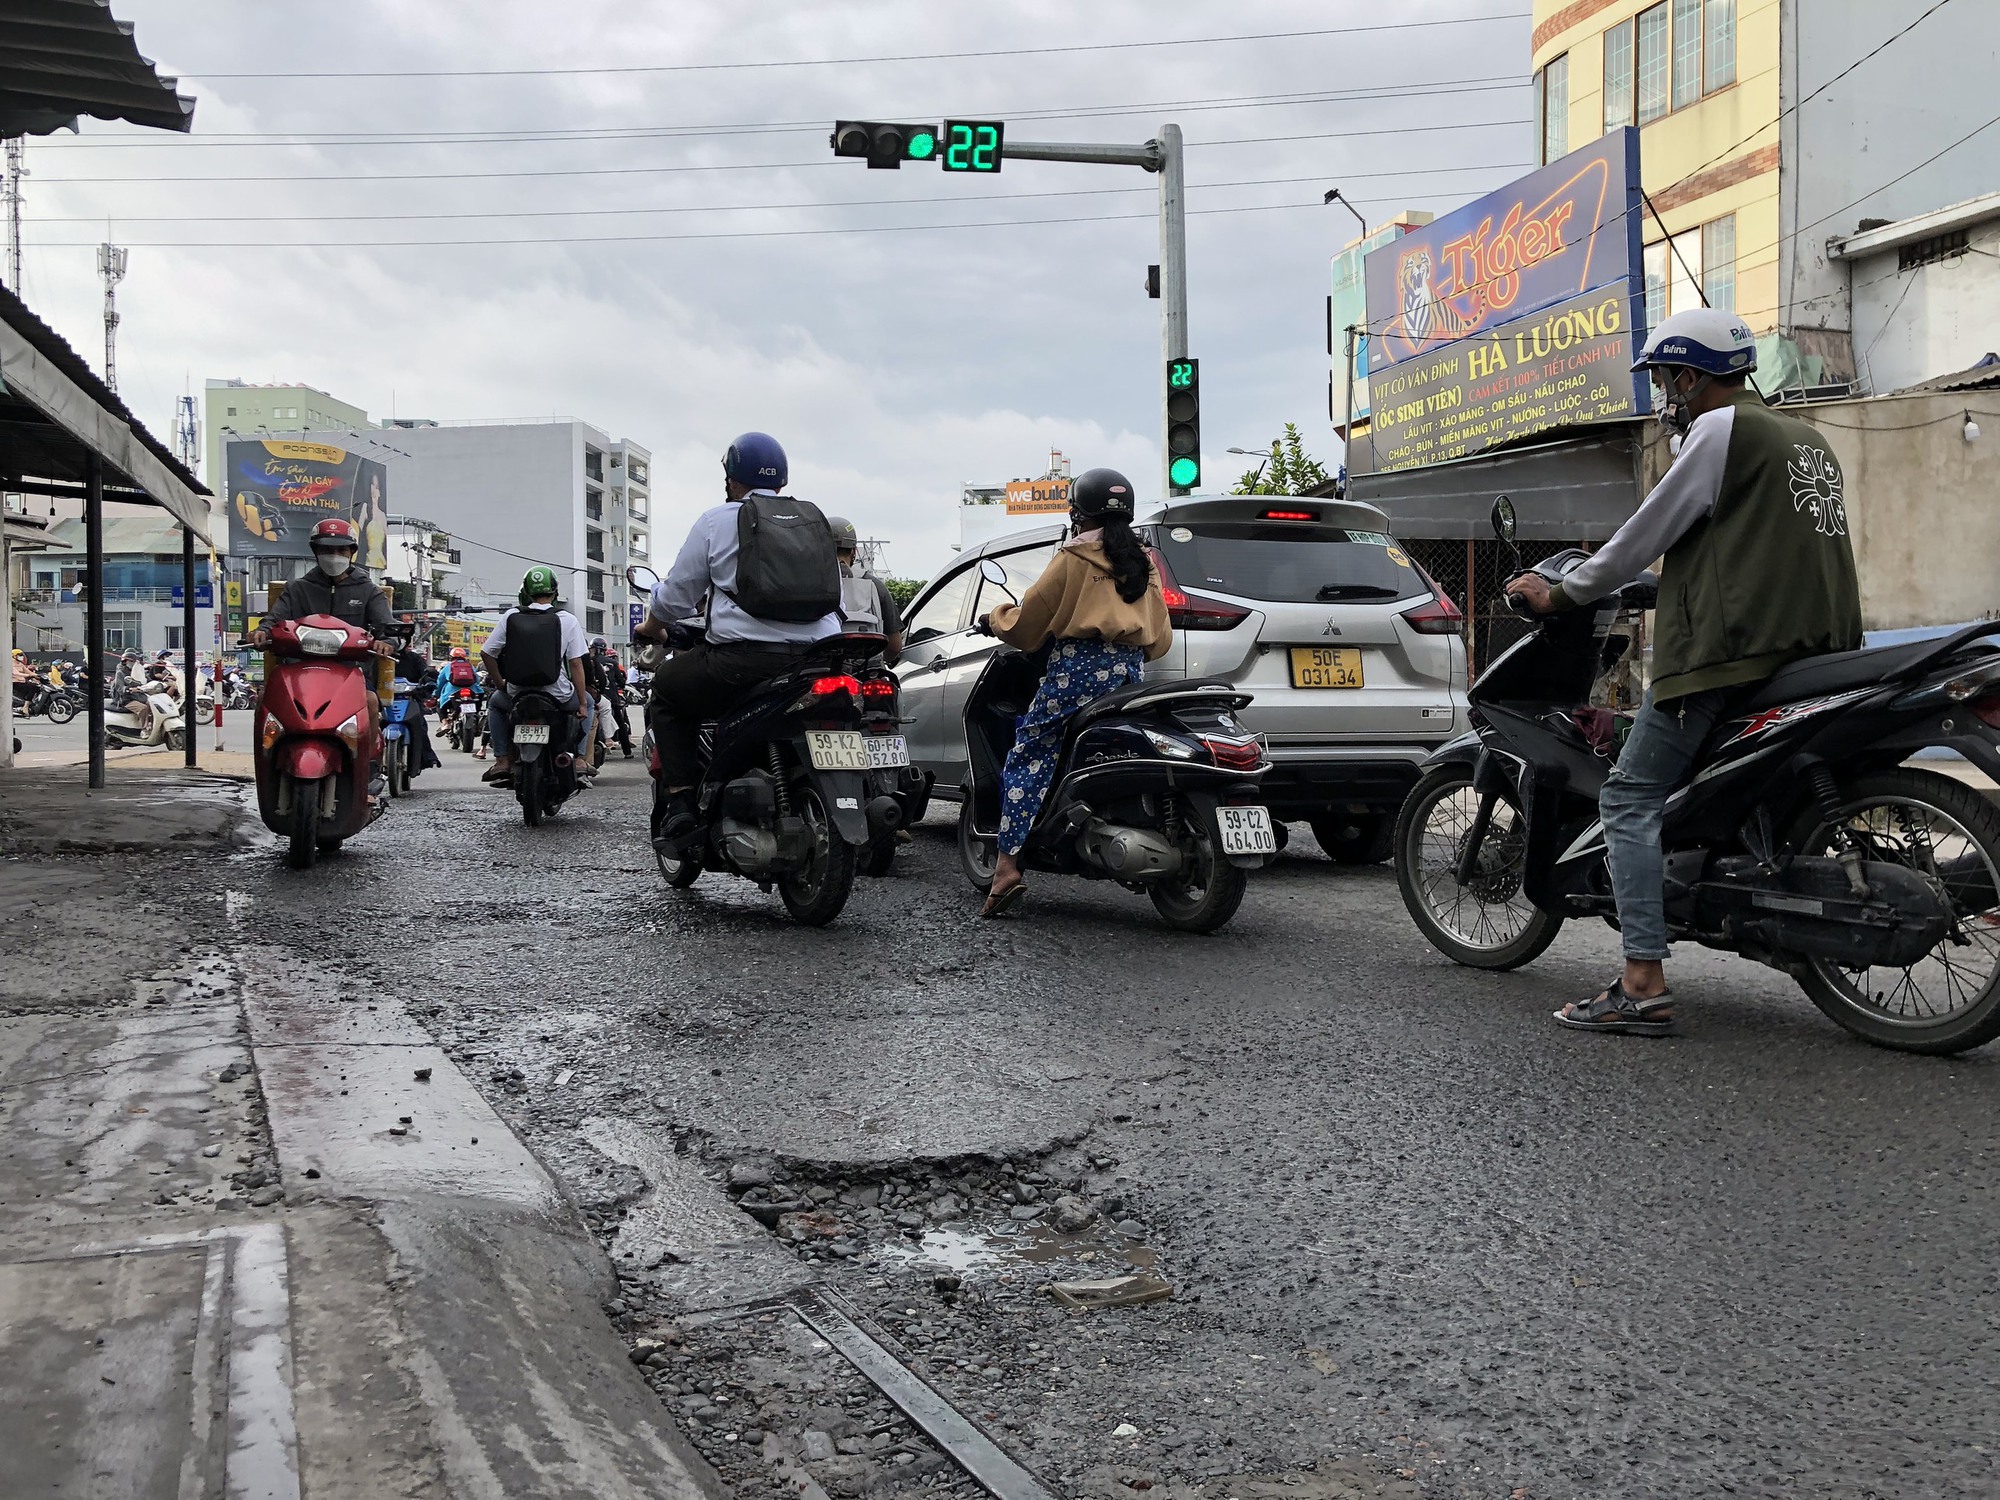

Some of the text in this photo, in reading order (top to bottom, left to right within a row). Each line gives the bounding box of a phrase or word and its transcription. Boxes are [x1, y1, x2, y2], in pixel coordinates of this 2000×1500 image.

[947, 125, 997, 169] 22
[1440, 200, 1574, 309] Tiger
[1468, 333, 1508, 381] HÀ
[1515, 298, 1621, 364] LƯƠNG
[1663, 344, 1688, 355] Bifina
[1171, 363, 1193, 387] 22
[1374, 357, 1459, 403] VỊT CỎ VÂN ĐÌNH
[1469, 340, 1623, 402] CAM KẾT 100% TIẾT CANH VỊT
[1374, 385, 1462, 432] (ỐC SINH VIÊN)
[1420, 422, 1433, 436] VỊT
[1439, 413, 1457, 429] XÁO
[1459, 405, 1484, 423] MĂNG
[1492, 399, 1506, 413] OM
[1508, 389, 1527, 408] SẤU
[1534, 380, 1555, 399] NẤU
[1557, 373, 1587, 393] CHAO
[1575, 408, 1595, 423] Quý
[1596, 396, 1629, 418] Khách
[1388, 445, 1411, 461] CHÁO
[1416, 437, 1433, 453] BÚN
[1440, 429, 1461, 446] MIẾN
[1462, 422, 1488, 440] MĂNG
[1490, 417, 1505, 432] VỊT
[1512, 403, 1546, 426] NƯỚNG
[1554, 393, 1582, 413] LUỘC
[1590, 382, 1610, 402] GỎI
[294, 474, 313, 484] VAI
[758, 467, 777, 476] ACB
[287, 495, 340, 510] TOÀN THÂN
[1008, 484, 1069, 503] webuild
[1312, 650, 1343, 666] 50E
[1302, 668, 1356, 685] 031.34
[814, 734, 857, 750] 59-K2
[867, 739, 899, 752] 60-F4
[814, 751, 866, 767] 004.16
[1224, 810, 1264, 830] 59-C2
[1226, 831, 1272, 852] 464.00
